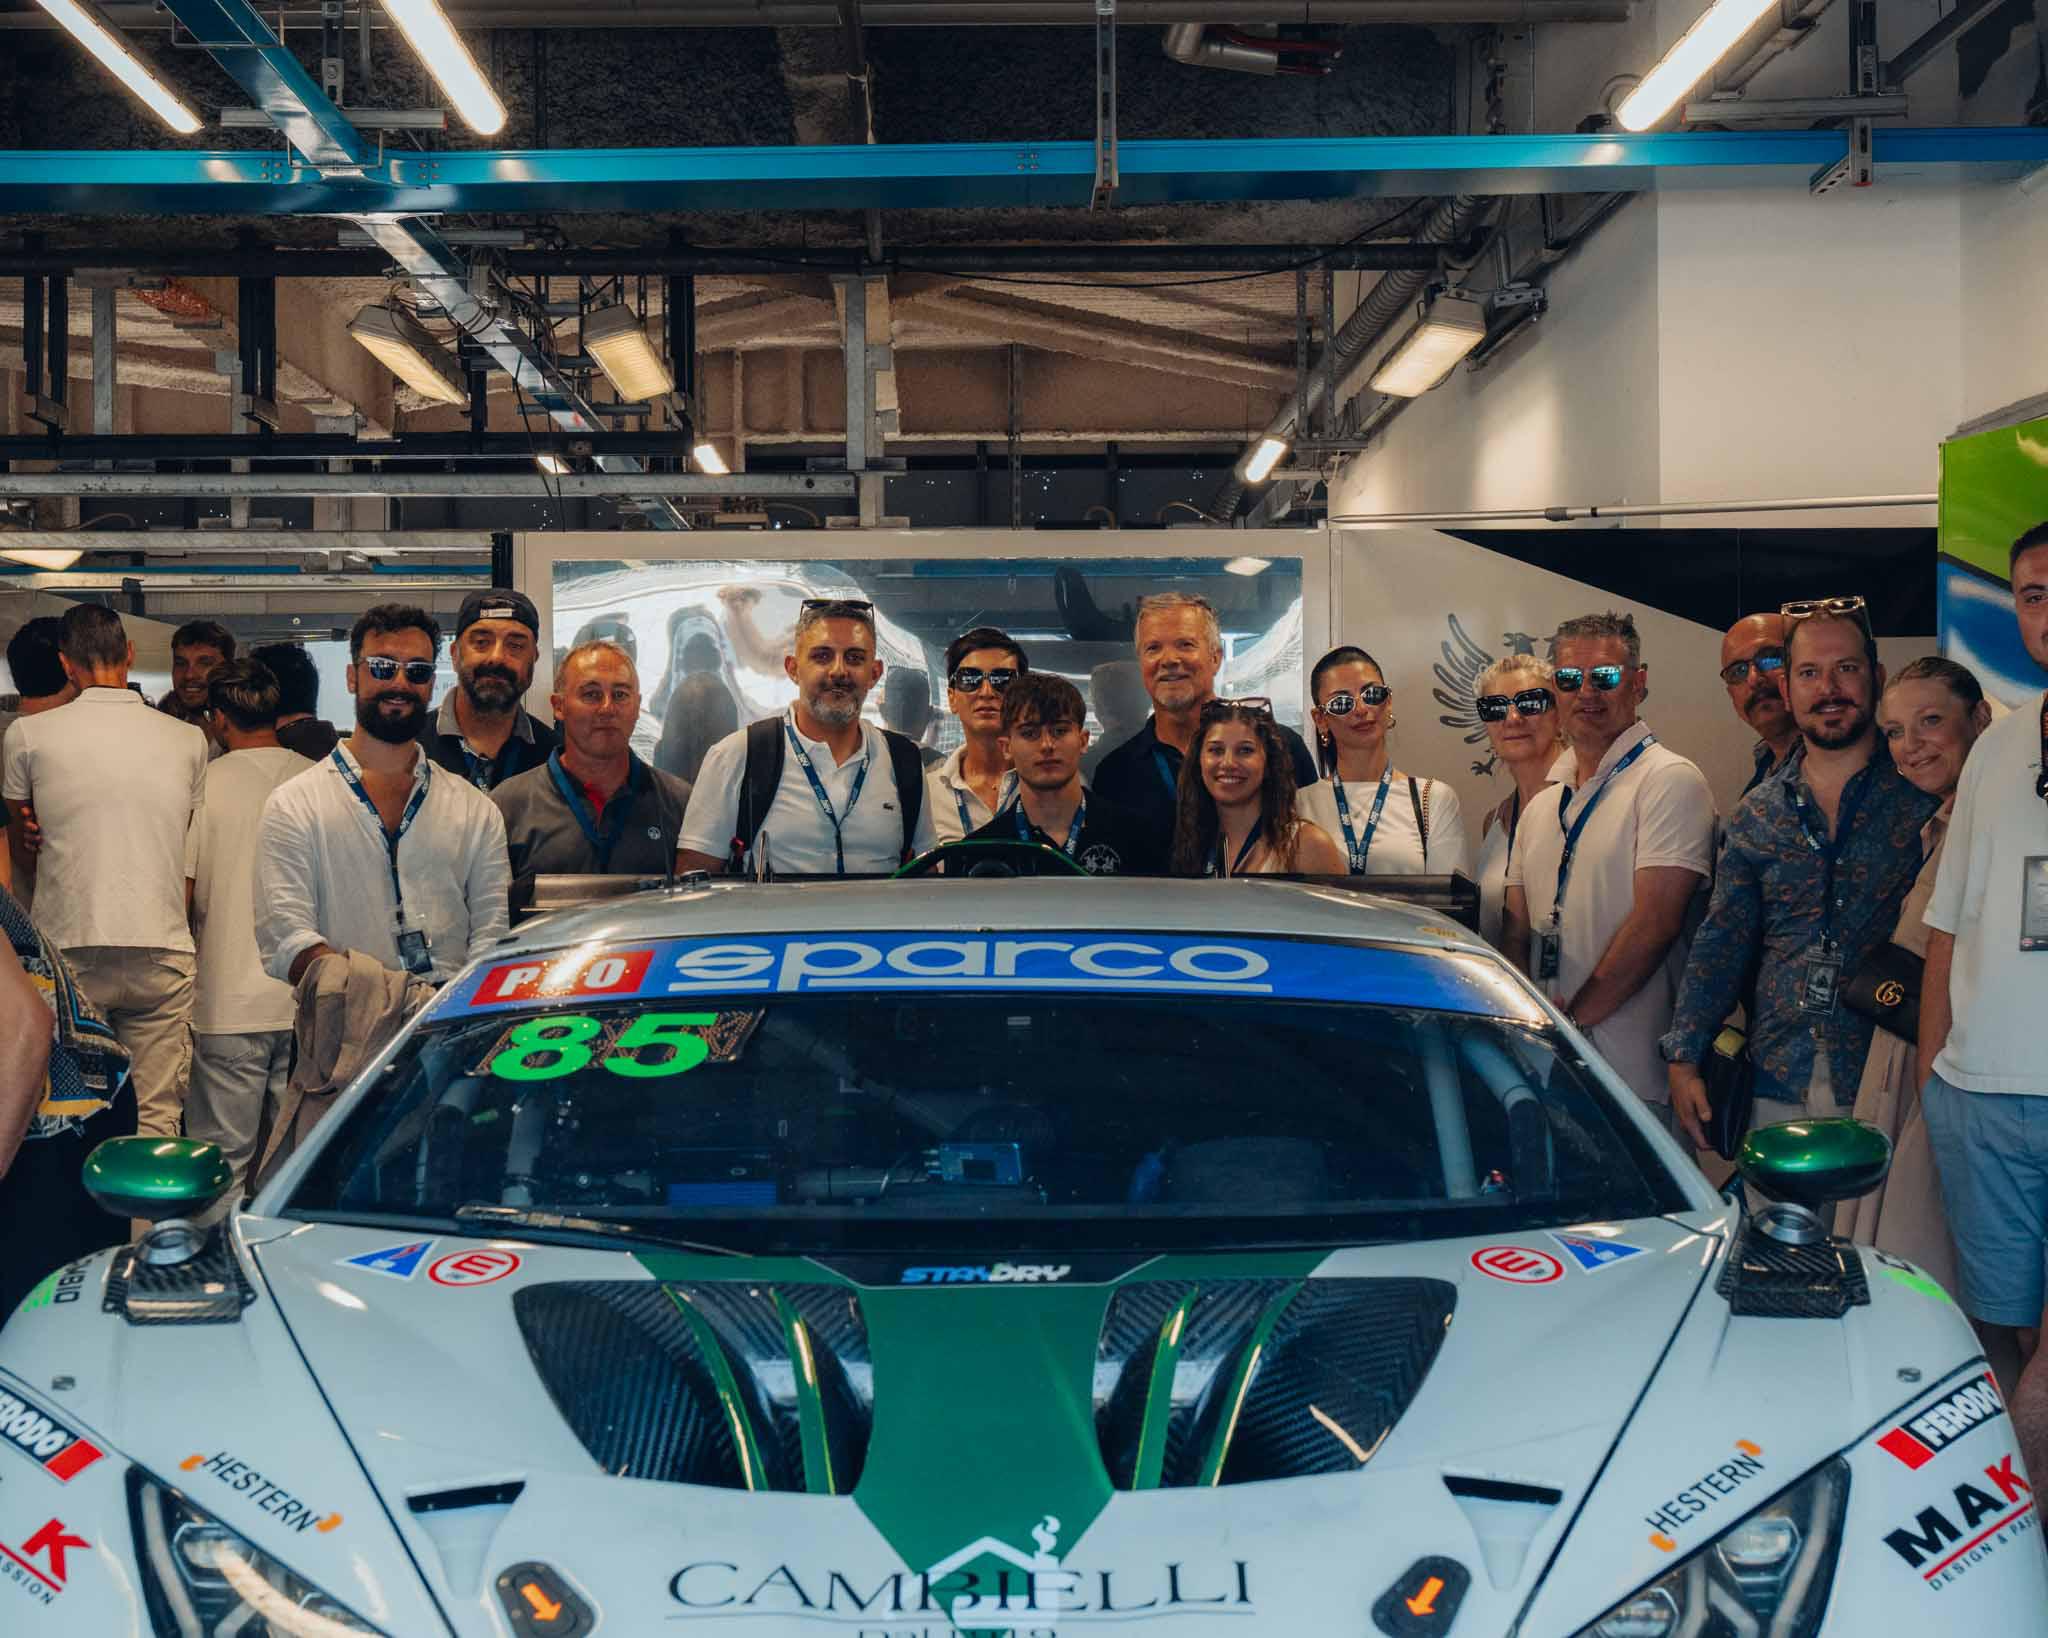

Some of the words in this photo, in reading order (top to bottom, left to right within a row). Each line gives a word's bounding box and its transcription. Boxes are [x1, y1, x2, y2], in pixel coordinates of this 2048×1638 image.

[674, 941, 1269, 992] sparco
[490, 1012, 718, 1081] 85
[901, 1263, 1071, 1283] STAYDRY
[0, 1391, 68, 1456] RODO
[1909, 1381, 2002, 1448] FERODO
[202, 1451, 321, 1533] HESTERN
[1644, 1453, 1765, 1535] HESTERN
[1882, 1453, 2032, 1568] MAK
[0, 1554, 54, 1605] SSION
[669, 1561, 1252, 1612] CAMBIELLI
[1929, 1543, 1993, 1591] DESIGN
